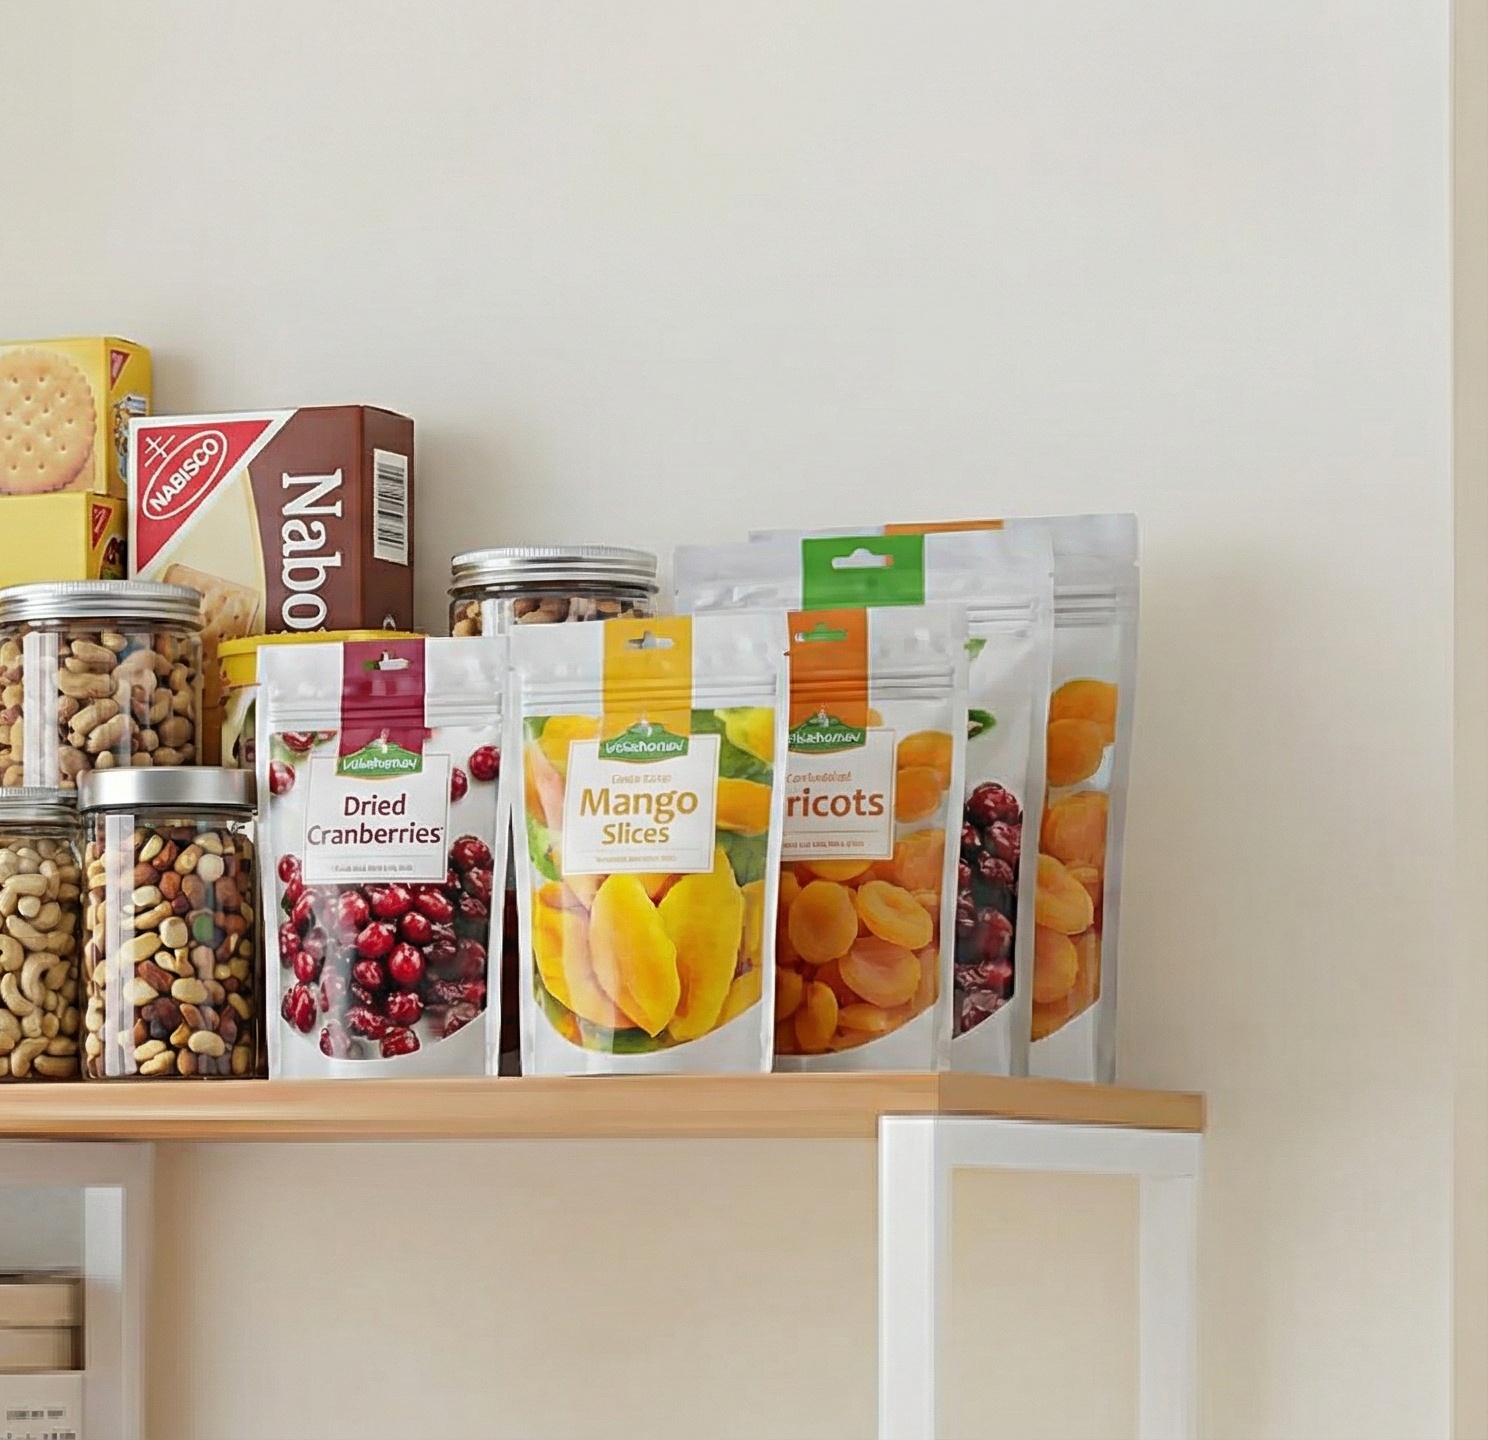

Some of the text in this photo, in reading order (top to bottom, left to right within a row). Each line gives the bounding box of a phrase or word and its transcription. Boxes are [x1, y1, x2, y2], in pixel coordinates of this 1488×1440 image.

[148, 437, 220, 512] NABISCO
[281, 468, 343, 633] Nabo
[344, 793, 407, 816] Dried
[579, 787, 699, 825] Mango
[786, 787, 885, 818] ricots
[307, 821, 443, 846] Cranberries
[601, 822, 670, 846] Slices
